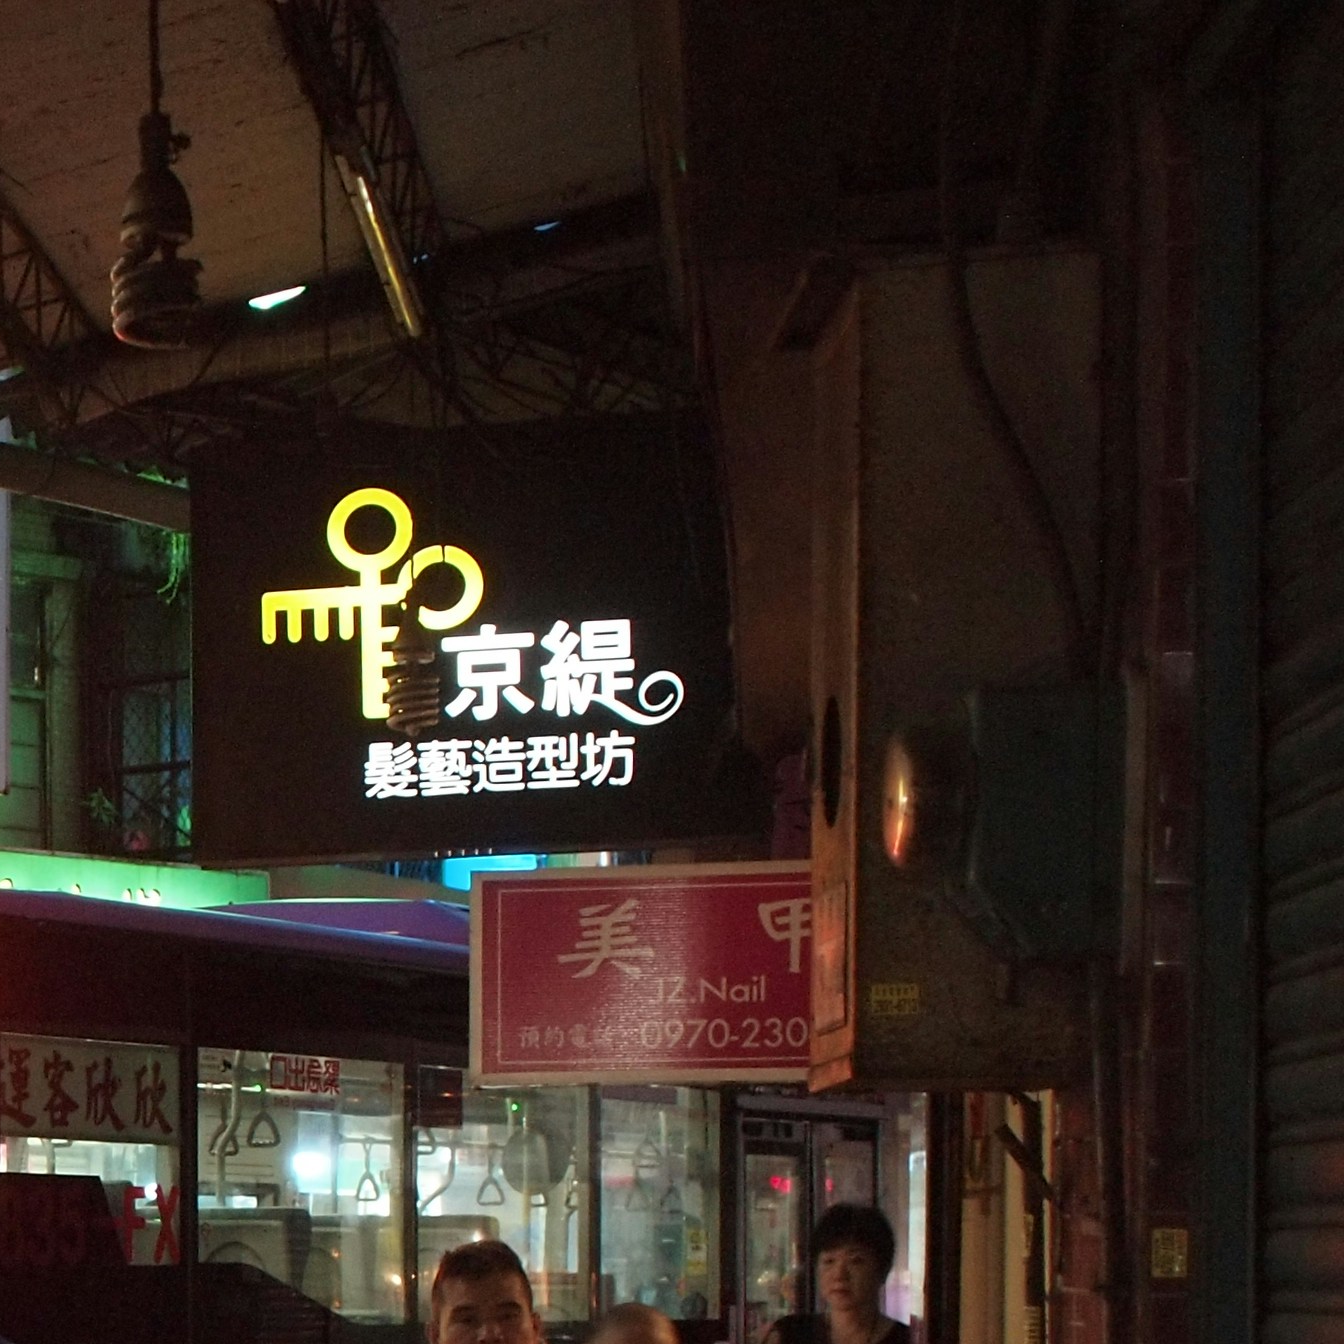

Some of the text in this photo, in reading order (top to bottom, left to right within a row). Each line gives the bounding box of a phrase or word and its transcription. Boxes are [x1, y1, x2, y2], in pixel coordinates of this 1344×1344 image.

[441, 619, 684, 727] 京緹
[364, 730, 635, 799] 髮藝造型坊
